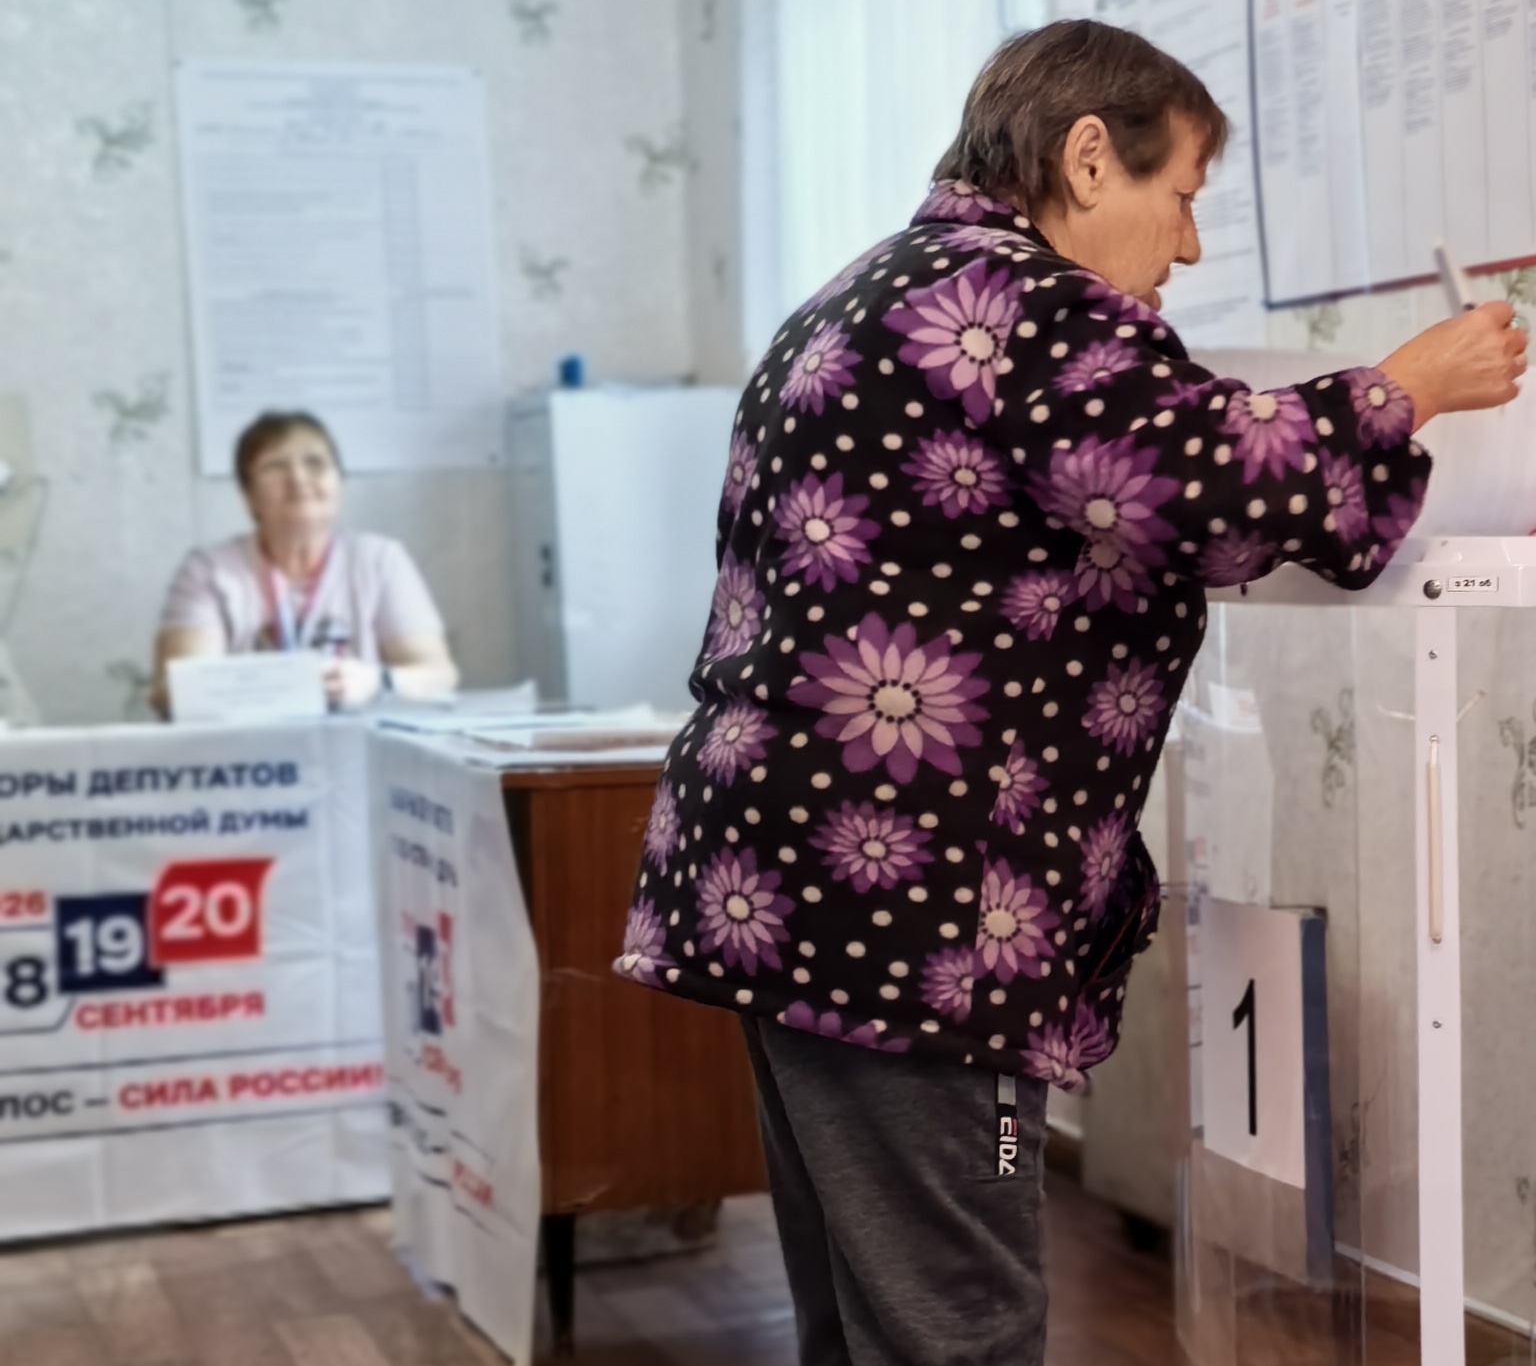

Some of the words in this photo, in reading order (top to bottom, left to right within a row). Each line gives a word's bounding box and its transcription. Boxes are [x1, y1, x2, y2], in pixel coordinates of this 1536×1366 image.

[87, 762, 300, 798] ДЕПУТАТОВ
[217, 808, 309, 835] ДУМЫ
[1, 891, 47, 919] 26
[64, 914, 145, 975] 19
[160, 881, 253, 942] 20
[75, 991, 265, 1031] СЕНТЯБРЯ
[1232, 978, 1258, 1136] 1
[118, 1076, 218, 1111] СИЛА
[227, 1063, 383, 1099] РОССИИ!
